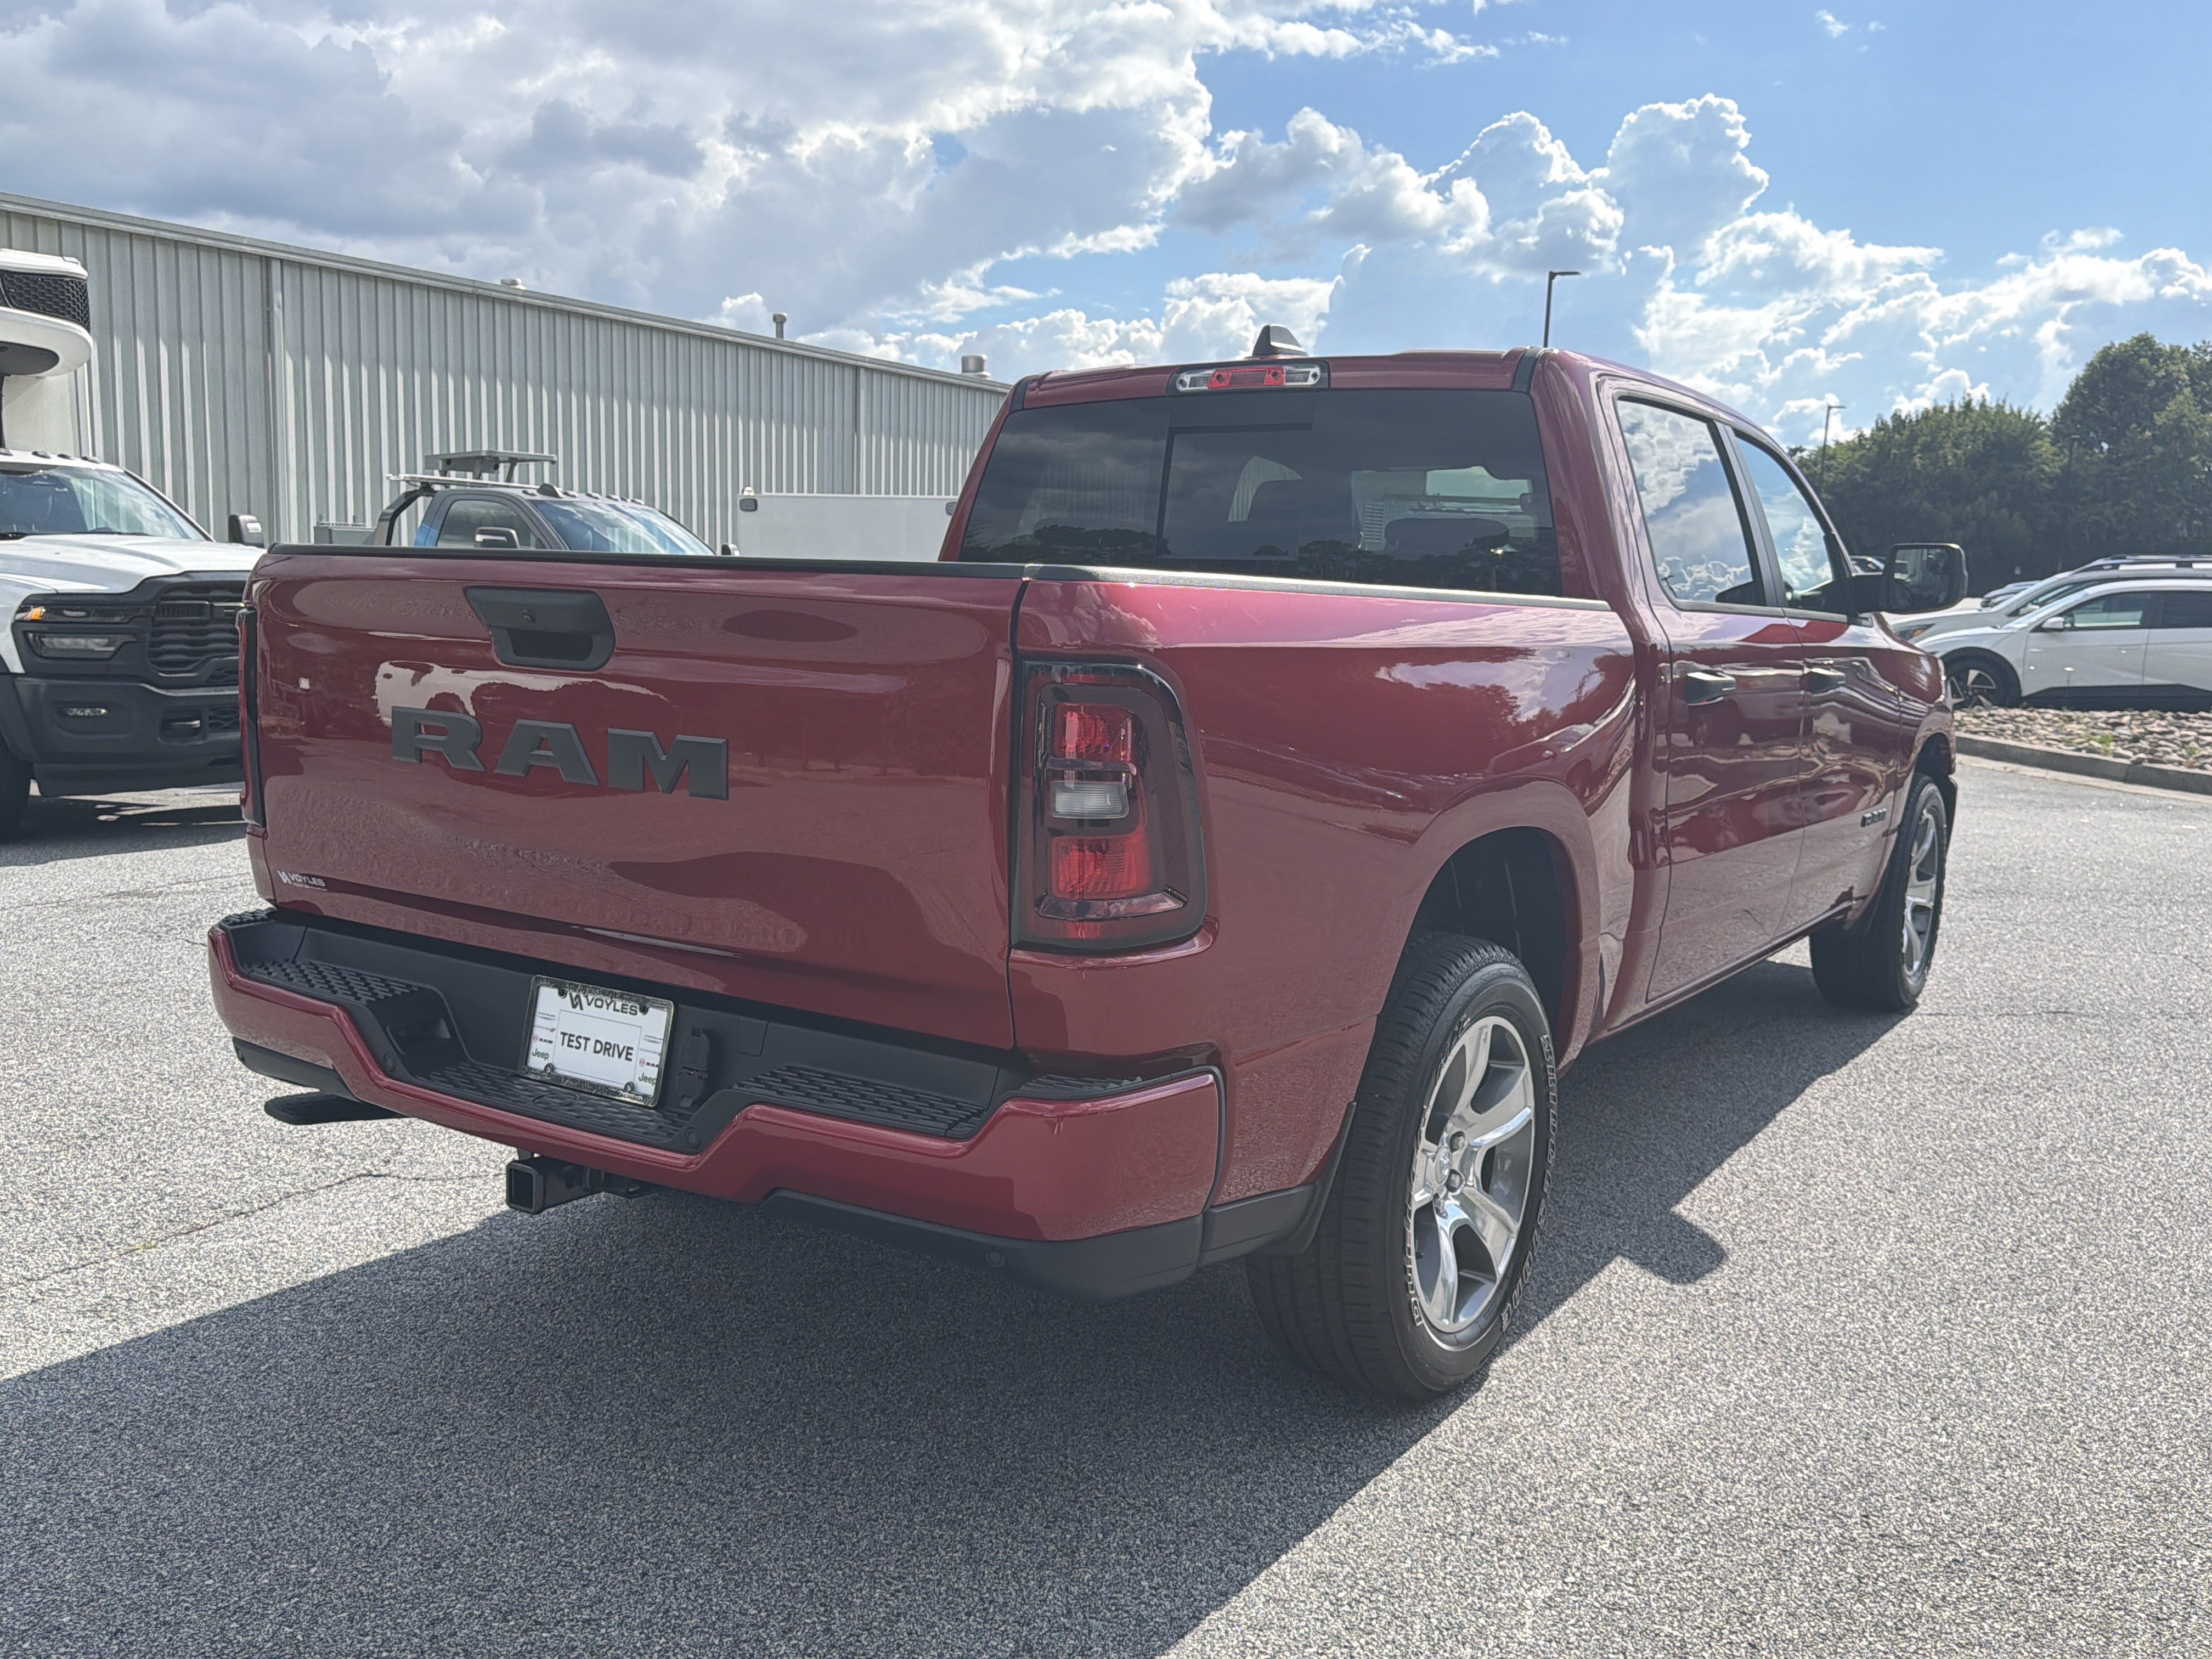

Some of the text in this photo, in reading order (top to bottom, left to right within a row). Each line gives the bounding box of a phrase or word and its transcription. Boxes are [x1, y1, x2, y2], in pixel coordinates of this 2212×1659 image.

[392, 706, 729, 800] RAM
[288, 872, 326, 887] VOYLES
[585, 997, 638, 1015] VOYLES
[532, 1048, 549, 1060] Jeep
[560, 1031, 634, 1062] TEST DRIVE
